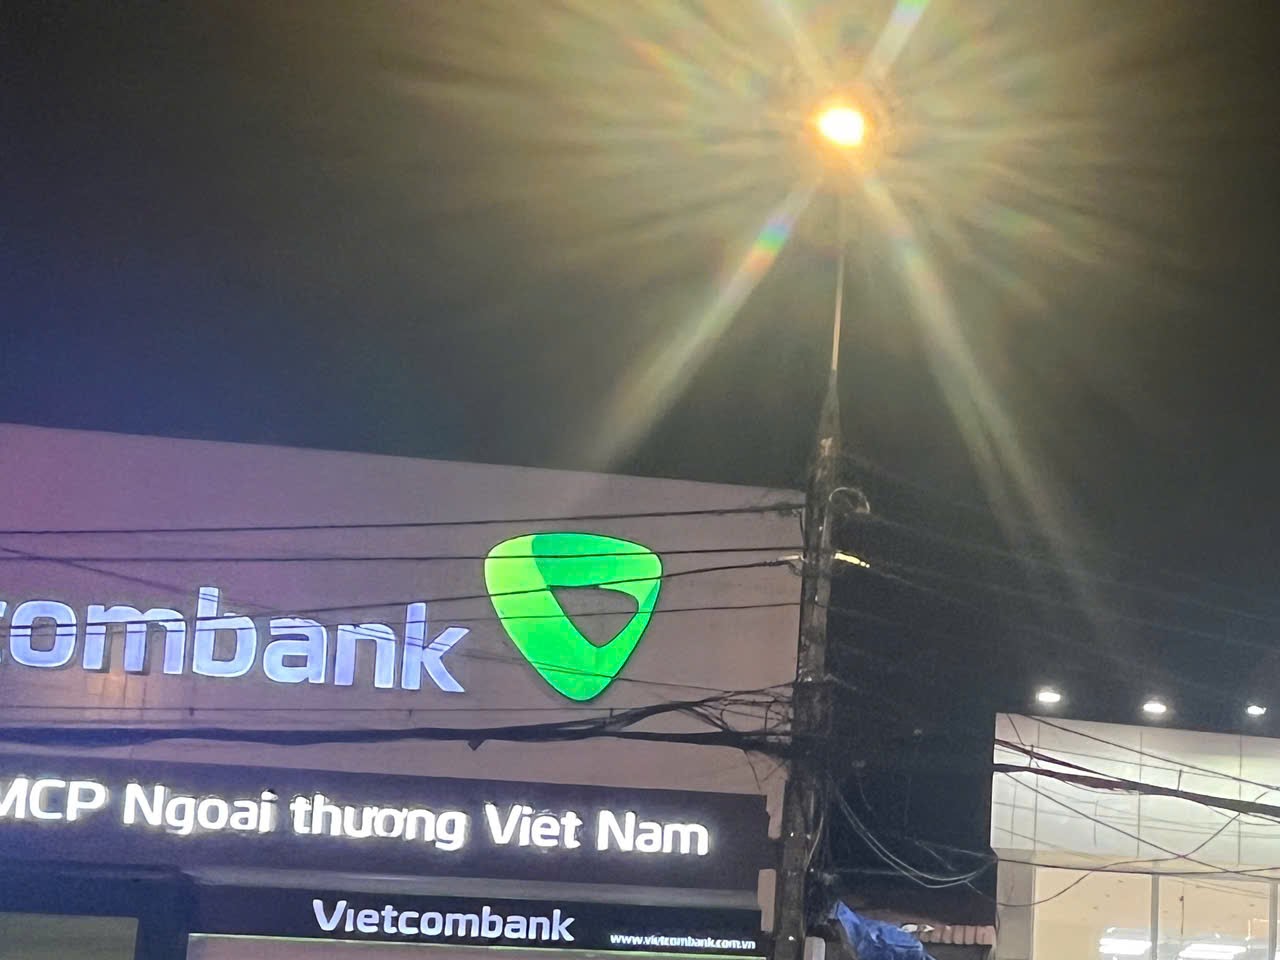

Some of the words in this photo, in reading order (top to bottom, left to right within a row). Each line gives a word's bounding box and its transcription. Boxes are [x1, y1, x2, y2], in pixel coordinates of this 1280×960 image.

[0, 585, 470, 694] ombank
[597, 809, 709, 856] Nam
[312, 899, 576, 942] Vietcombank
